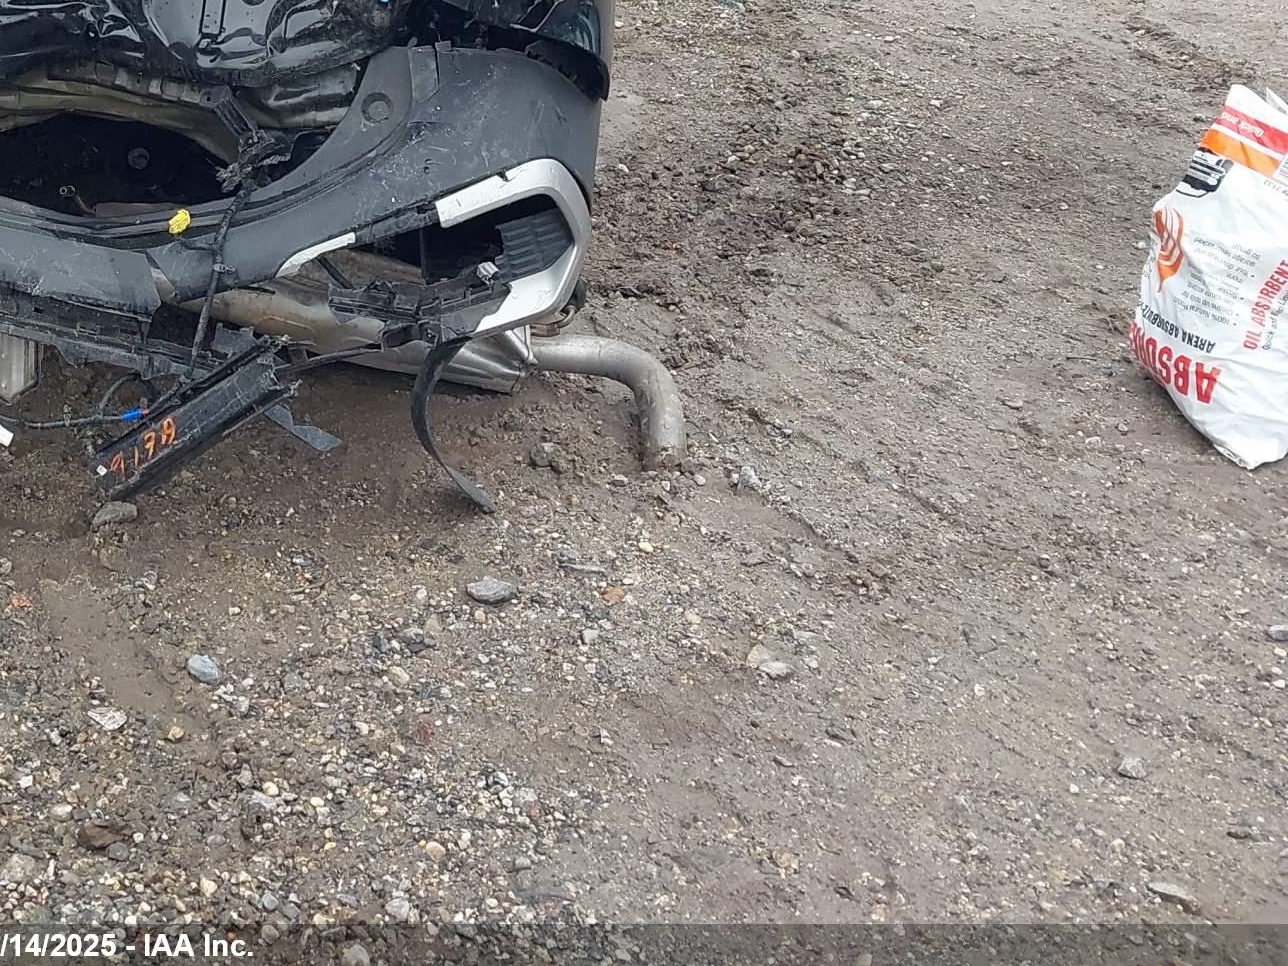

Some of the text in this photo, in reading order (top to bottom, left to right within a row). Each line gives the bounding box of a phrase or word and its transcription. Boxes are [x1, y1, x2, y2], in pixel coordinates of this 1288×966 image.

[1220, 111, 1264, 138] Quick and
[1180, 327, 1216, 353] ARENA
[1243, 330, 1263, 350] OIL
